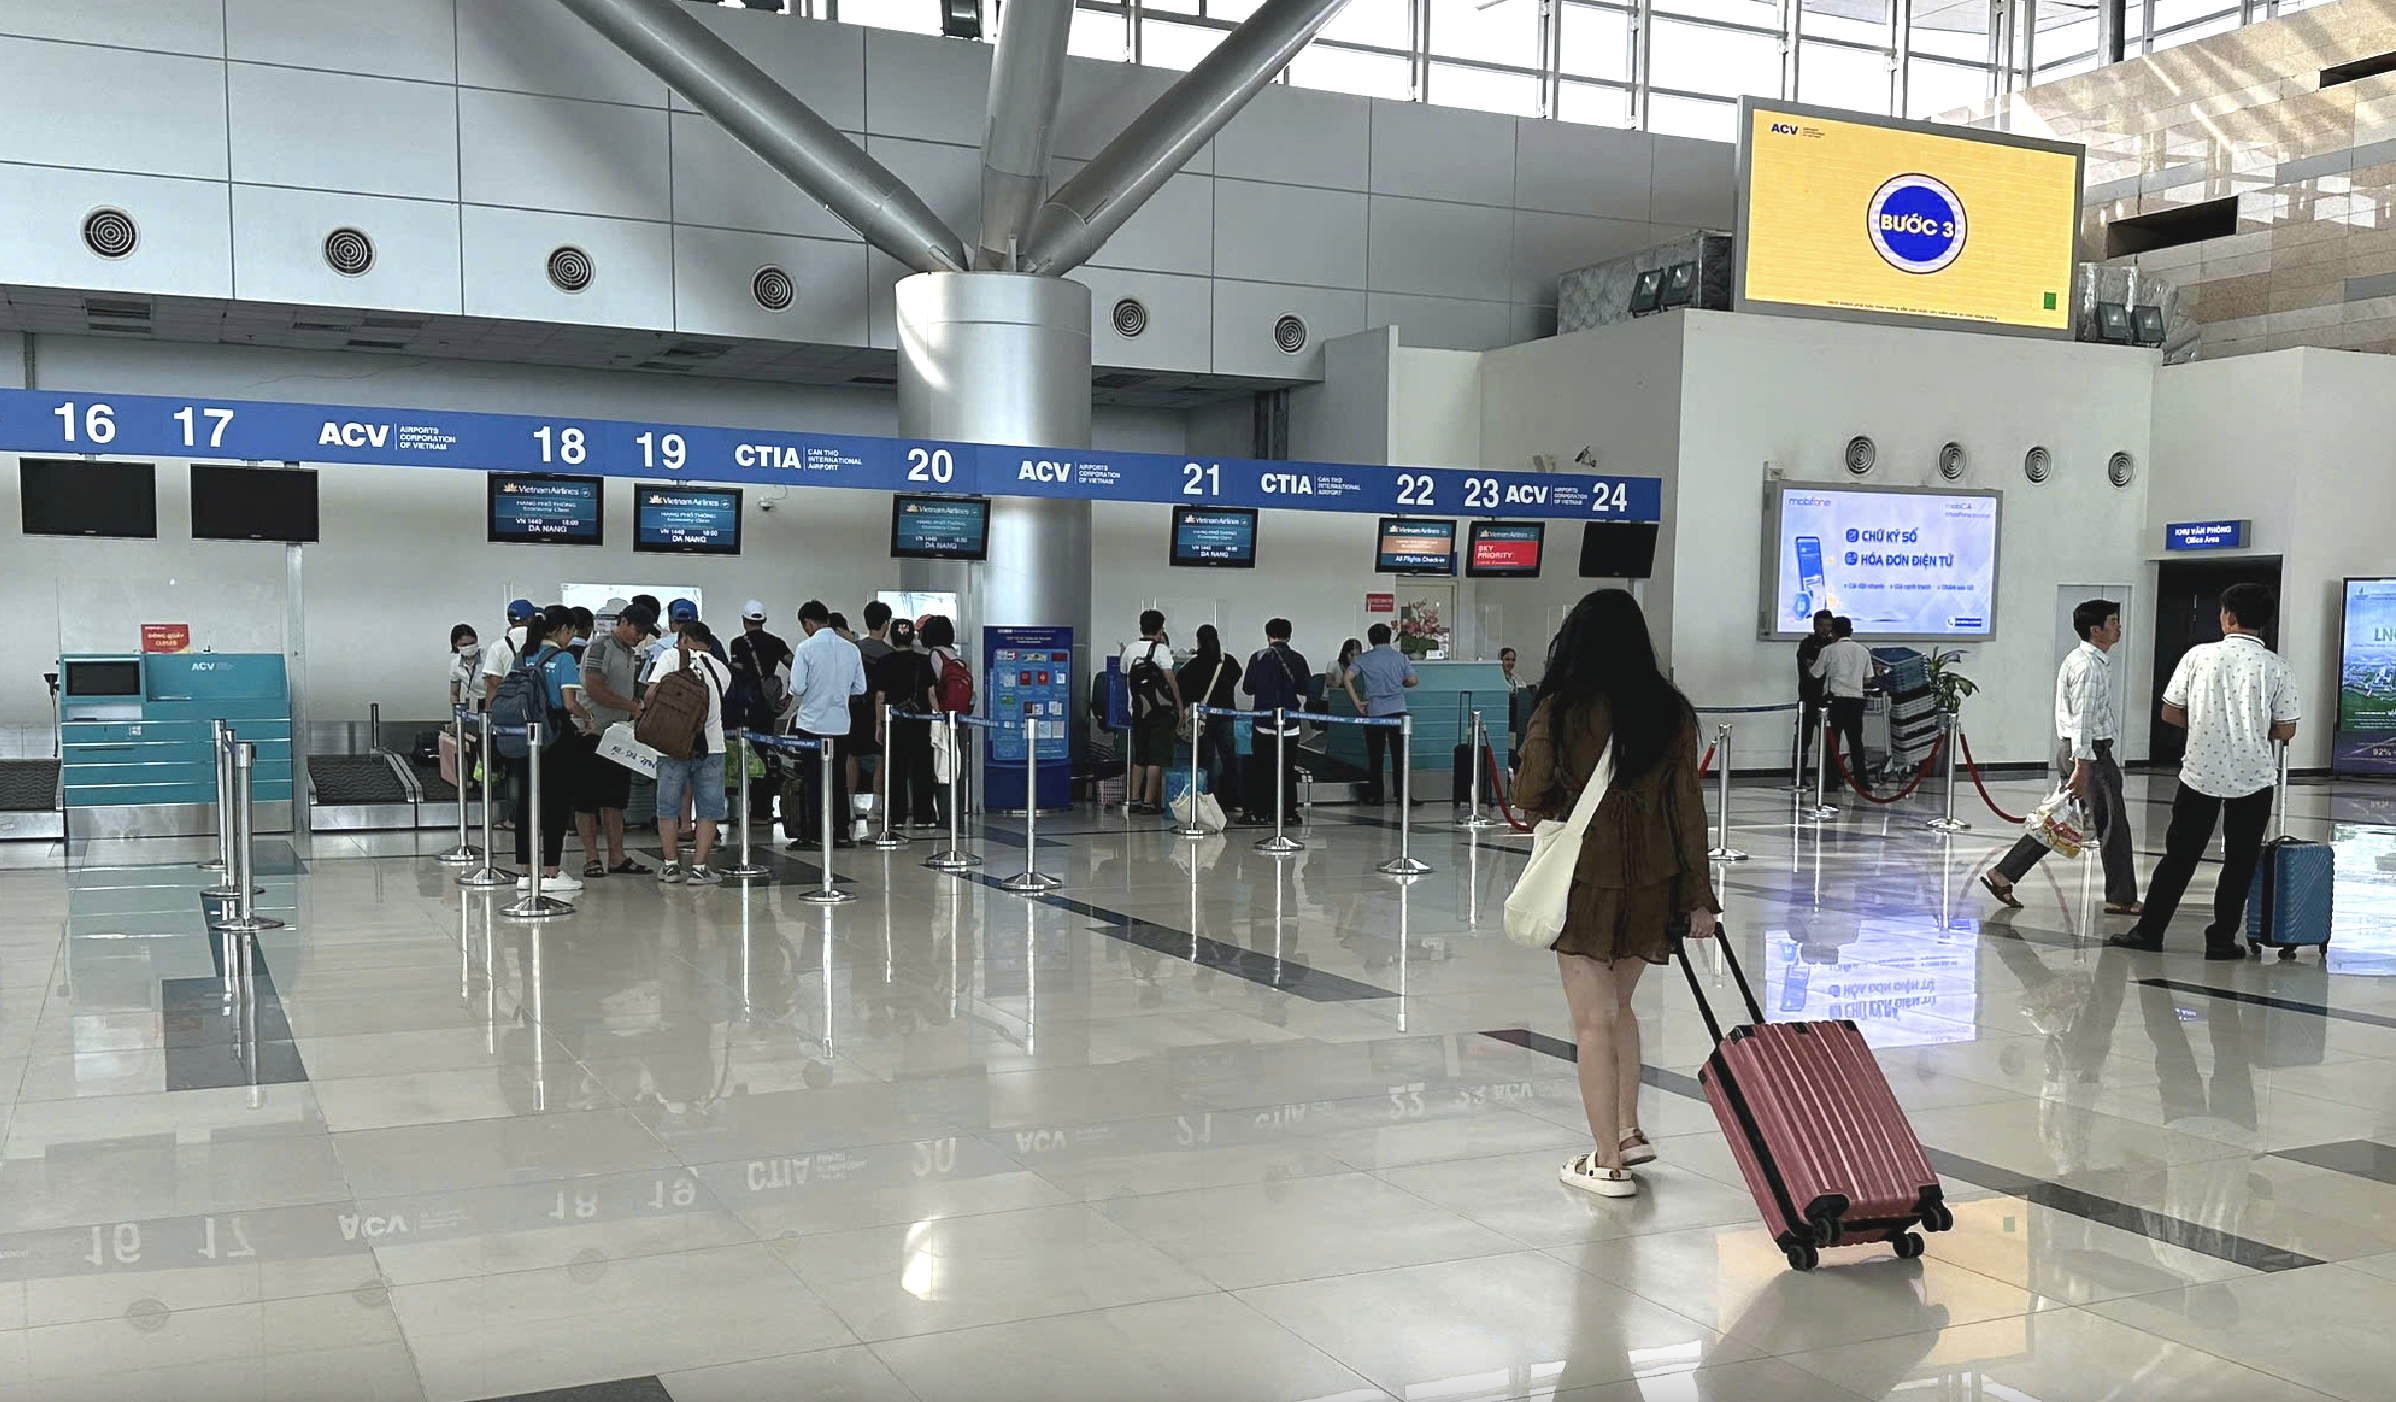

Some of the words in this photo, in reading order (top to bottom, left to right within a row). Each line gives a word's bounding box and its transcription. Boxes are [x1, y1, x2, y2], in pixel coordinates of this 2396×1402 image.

[1771, 124, 1798, 135] ACV
[1881, 213, 1938, 236] BƯỚC
[1942, 221, 1955, 238] 3
[54, 401, 116, 444] 16
[173, 406, 234, 448] 17
[400, 426, 439, 434] AIRPORTS
[318, 422, 390, 448] ACV
[400, 434, 456, 443] CORPORATION
[413, 442, 447, 450] VIETNAM
[533, 425, 586, 465] 18
[636, 431, 686, 470] 19
[735, 444, 802, 469] CTIA
[808, 456, 862, 465] INTERNATIONAL
[808, 463, 839, 471] AIRPORT
[907, 448, 953, 483] 20
[1018, 460, 1071, 483] ACV
[1183, 462, 1220, 496] 21
[1261, 473, 1313, 495] CTIA
[1397, 474, 1434, 506] 22
[1464, 478, 1499, 508] 23
[1505, 484, 1549, 504] ACV
[1592, 482, 1628, 512] 24
[528, 525, 540, 533] DA
[542, 525, 568, 533] NANG
[672, 535, 684, 543] DA
[685, 536, 708, 544] NANG
[1862, 528, 1885, 542] CHỮ
[1886, 529, 1900, 542] KÝ
[1902, 526, 1920, 542] SỐ
[1861, 553, 1884, 566] HÓA
[1885, 553, 1909, 566] ĐƠN
[1912, 553, 1937, 570] ĐIỆN
[192, 661, 215, 671] ACV
